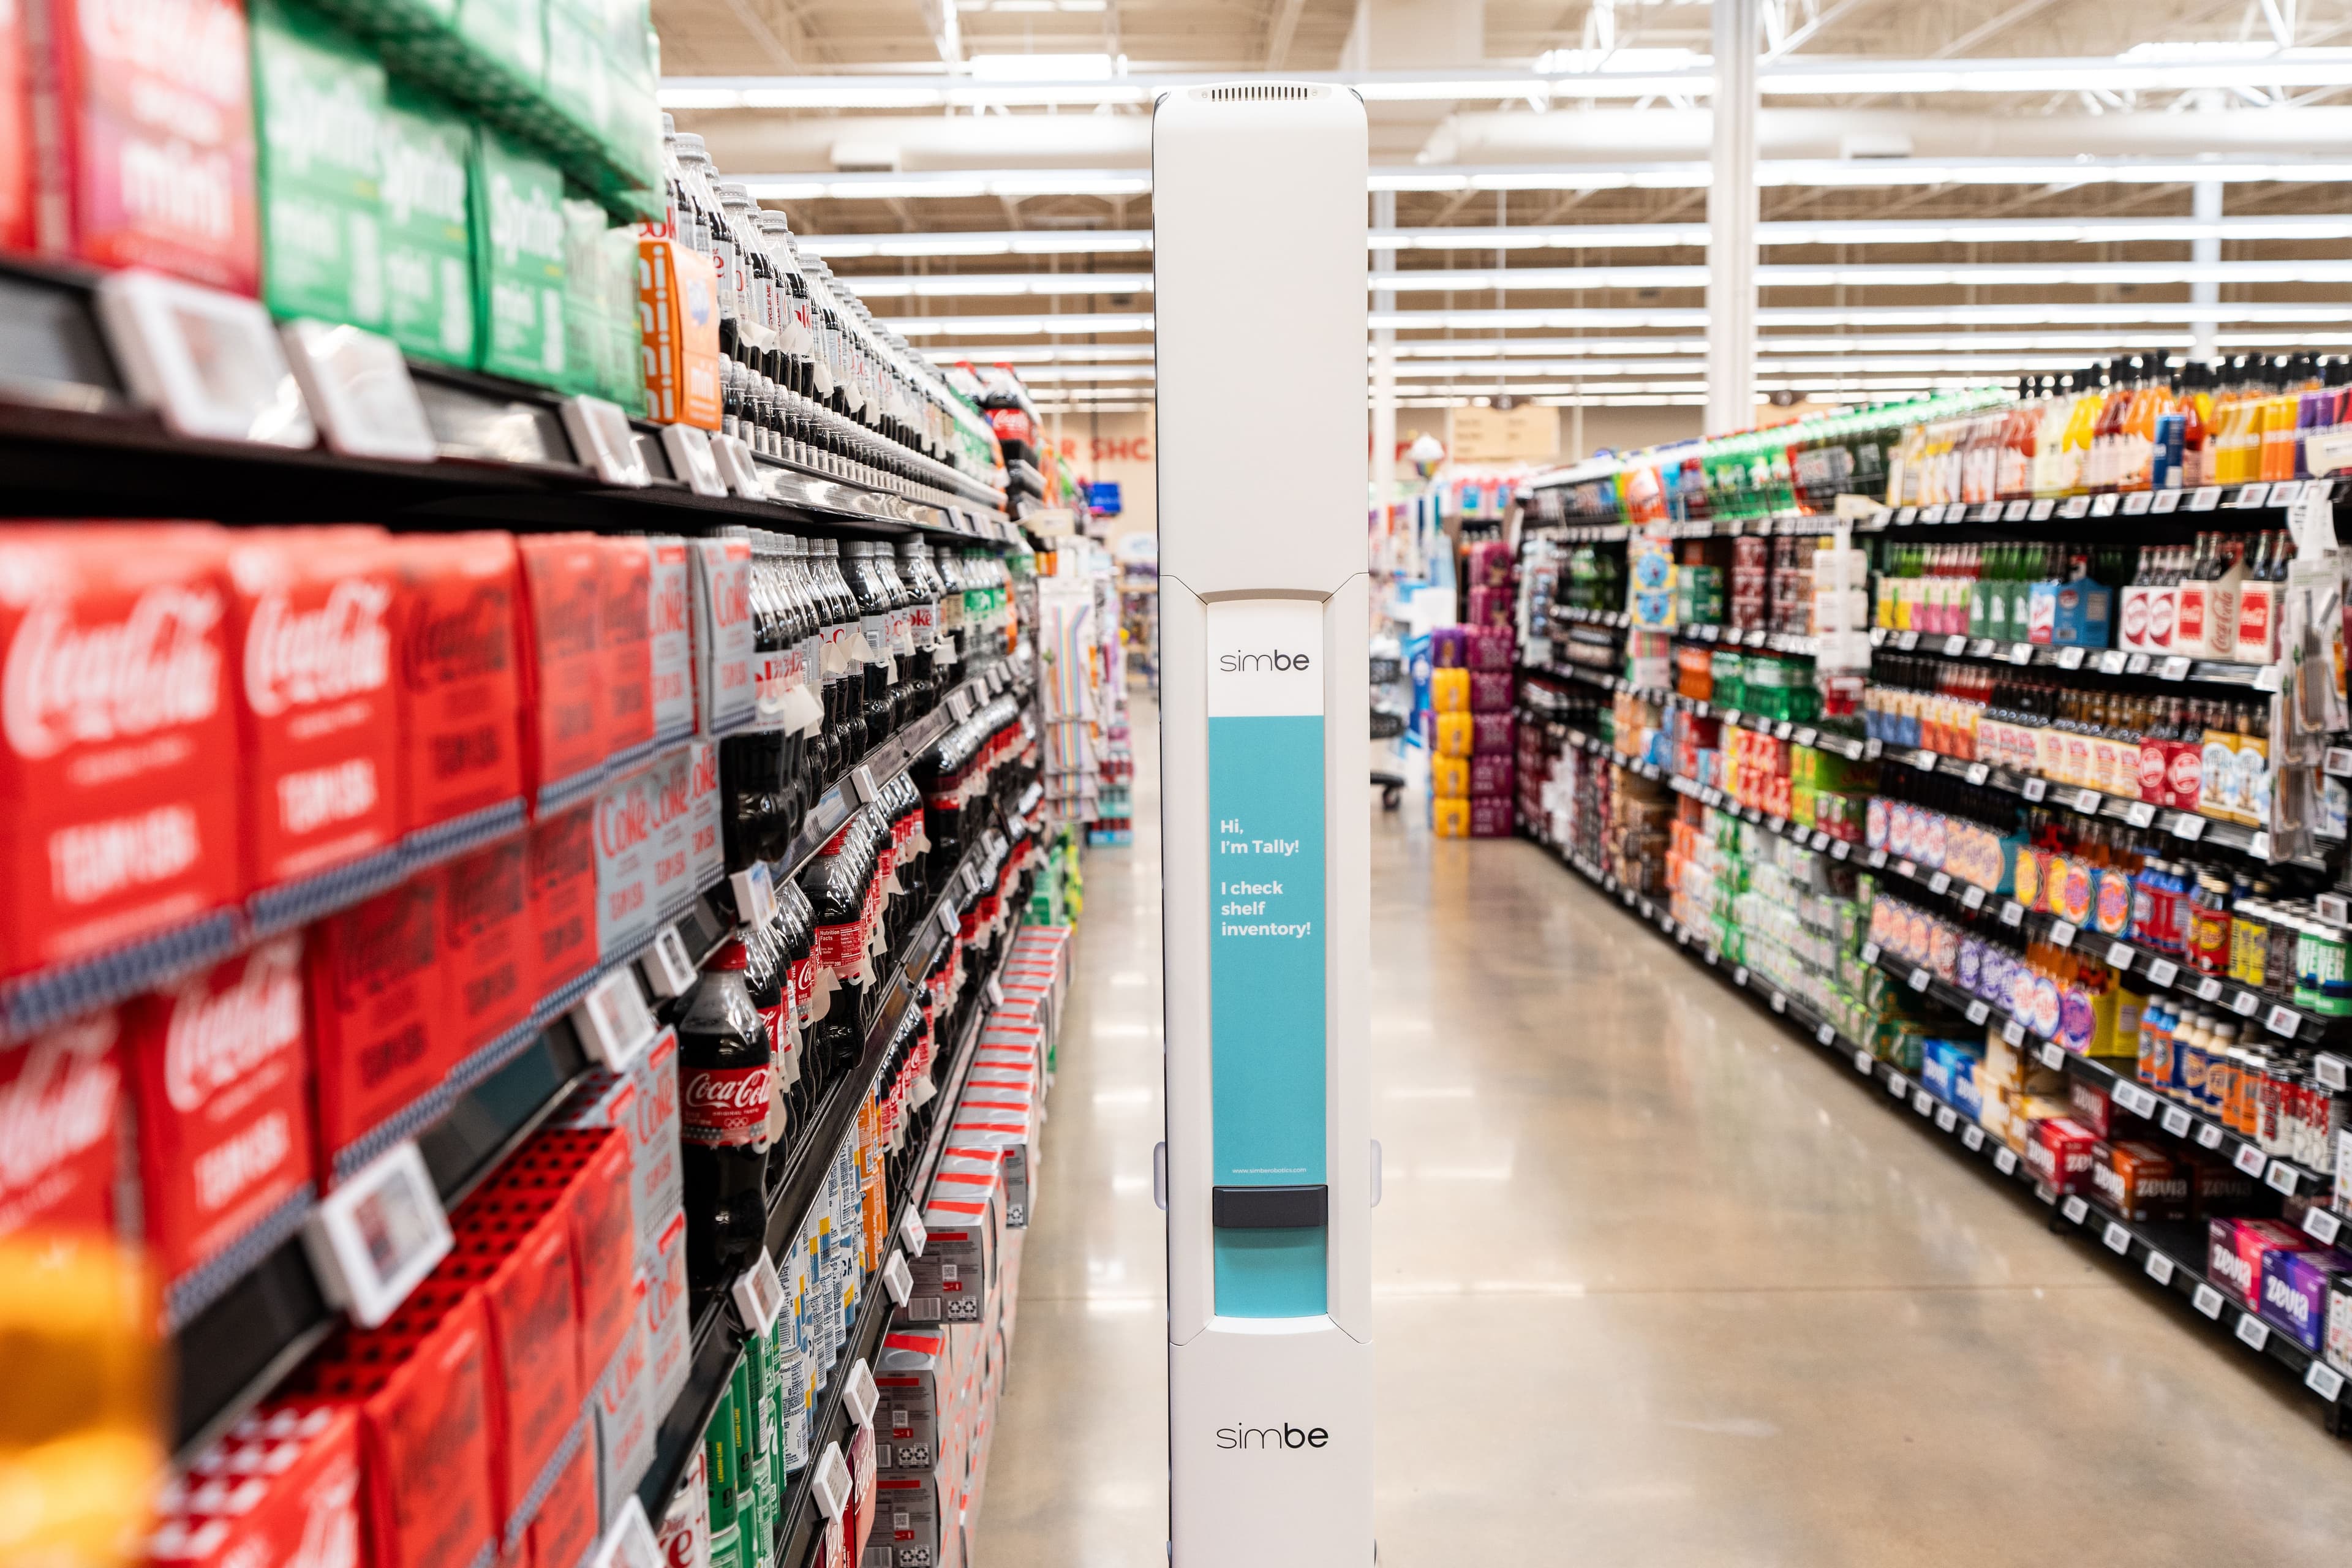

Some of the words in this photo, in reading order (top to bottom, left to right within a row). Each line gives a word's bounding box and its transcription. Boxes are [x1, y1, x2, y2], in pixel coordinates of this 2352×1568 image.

[1220, 649, 1310, 671] simbe
[1221, 818, 1244, 834] Hi,
[1251, 839, 1299, 856] Tally!
[1221, 881, 1226, 895] I
[1231, 880, 1283, 895] check
[1221, 901, 1266, 916] shelf
[1221, 921, 1311, 938] inventory!
[1216, 1422, 1329, 1449] simbe
[716, 1442, 725, 1483] LEMON-LIME
